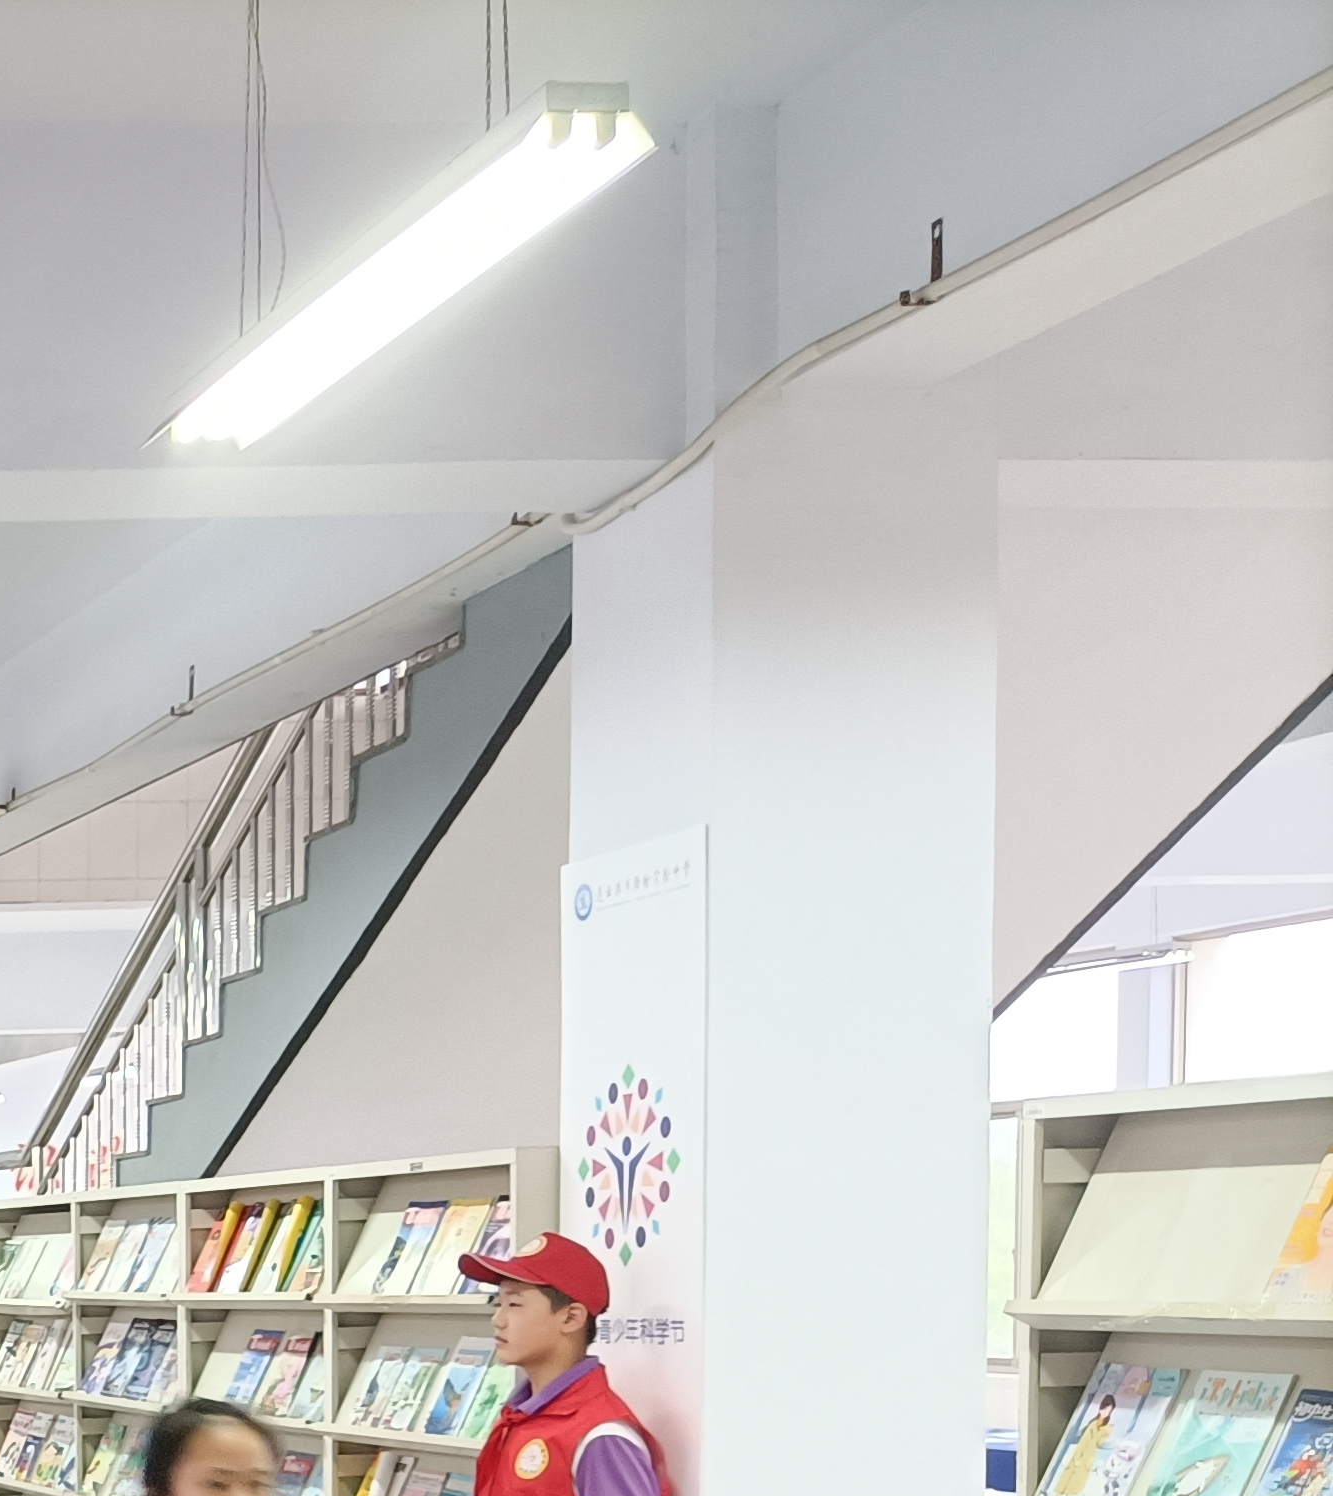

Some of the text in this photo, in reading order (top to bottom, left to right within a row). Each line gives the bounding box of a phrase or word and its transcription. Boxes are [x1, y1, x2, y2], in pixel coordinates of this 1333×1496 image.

[596, 1318, 685, 1345] 青少年科学节
